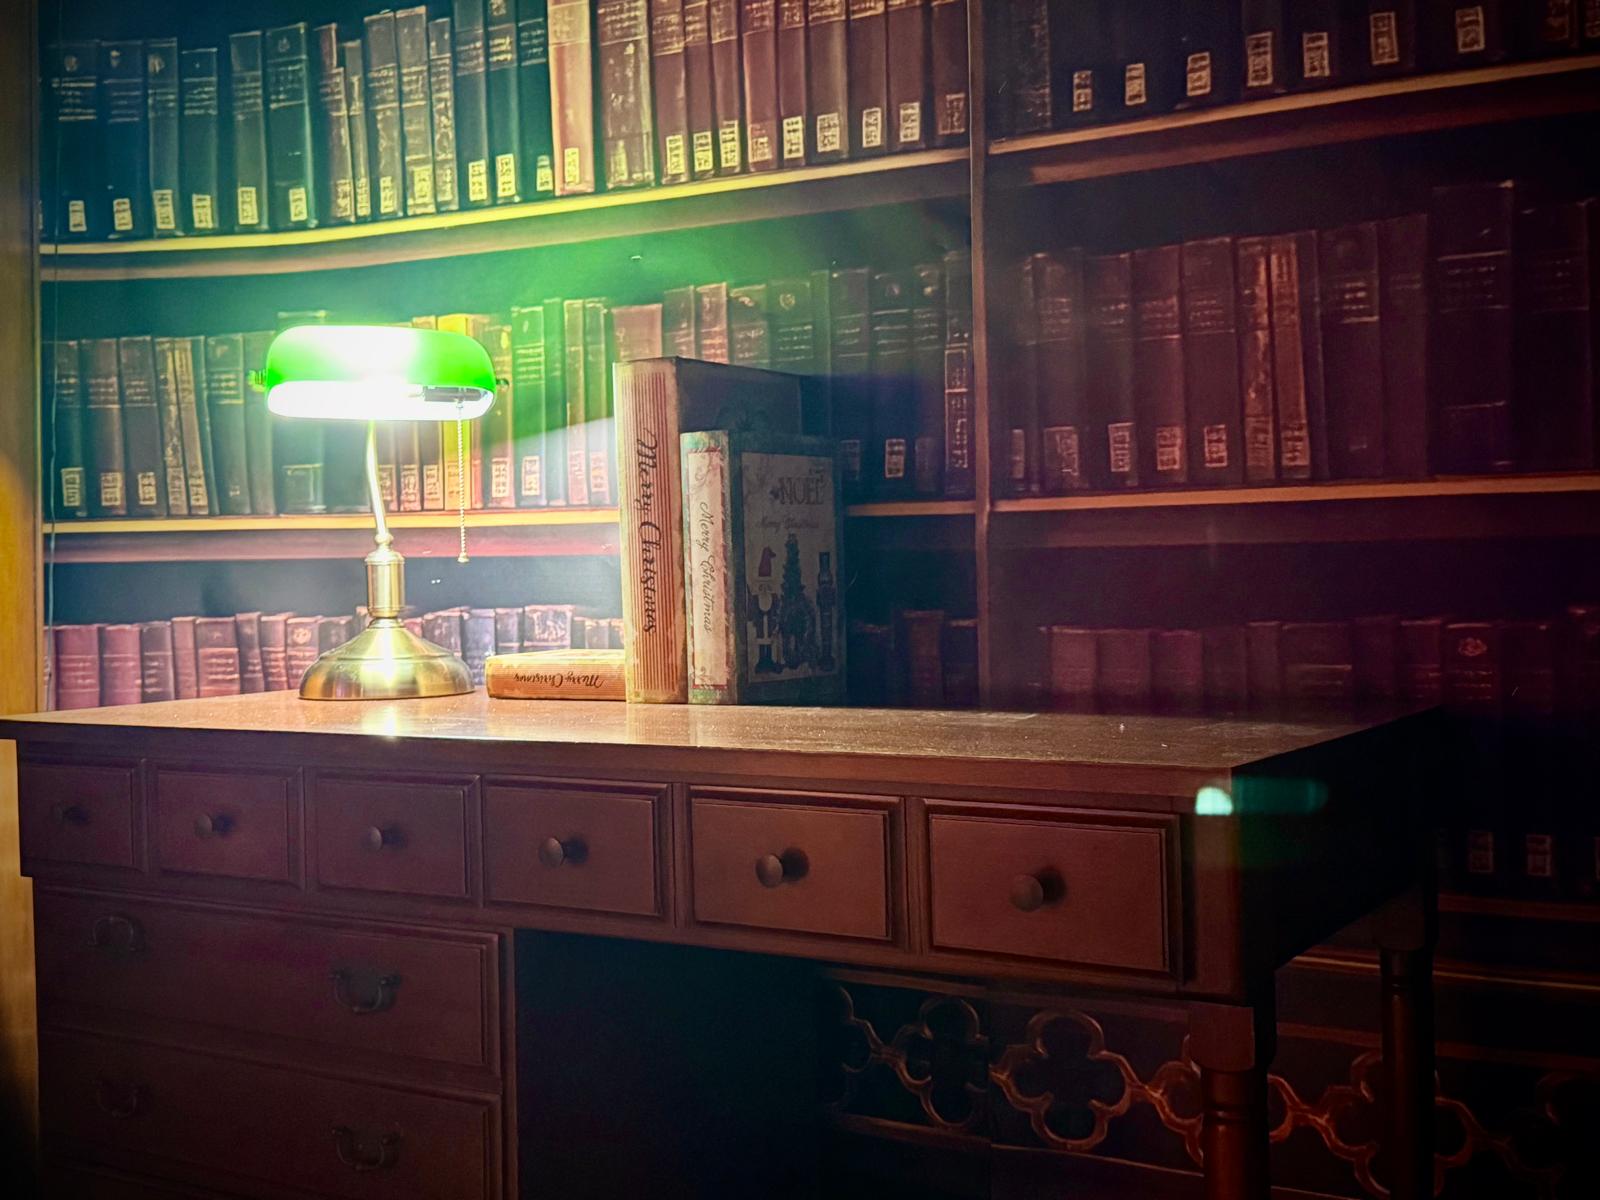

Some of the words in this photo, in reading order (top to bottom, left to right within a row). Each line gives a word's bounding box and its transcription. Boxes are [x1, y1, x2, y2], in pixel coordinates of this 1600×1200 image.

[633, 428, 658, 514] Merry
[779, 476, 824, 505] NOEL
[696, 501, 714, 551] Merry
[637, 521, 662, 635] Christmas
[700, 554, 716, 633] Christmas
[513, 672, 564, 688] Christmas
[565, 671, 605, 689] Merry
